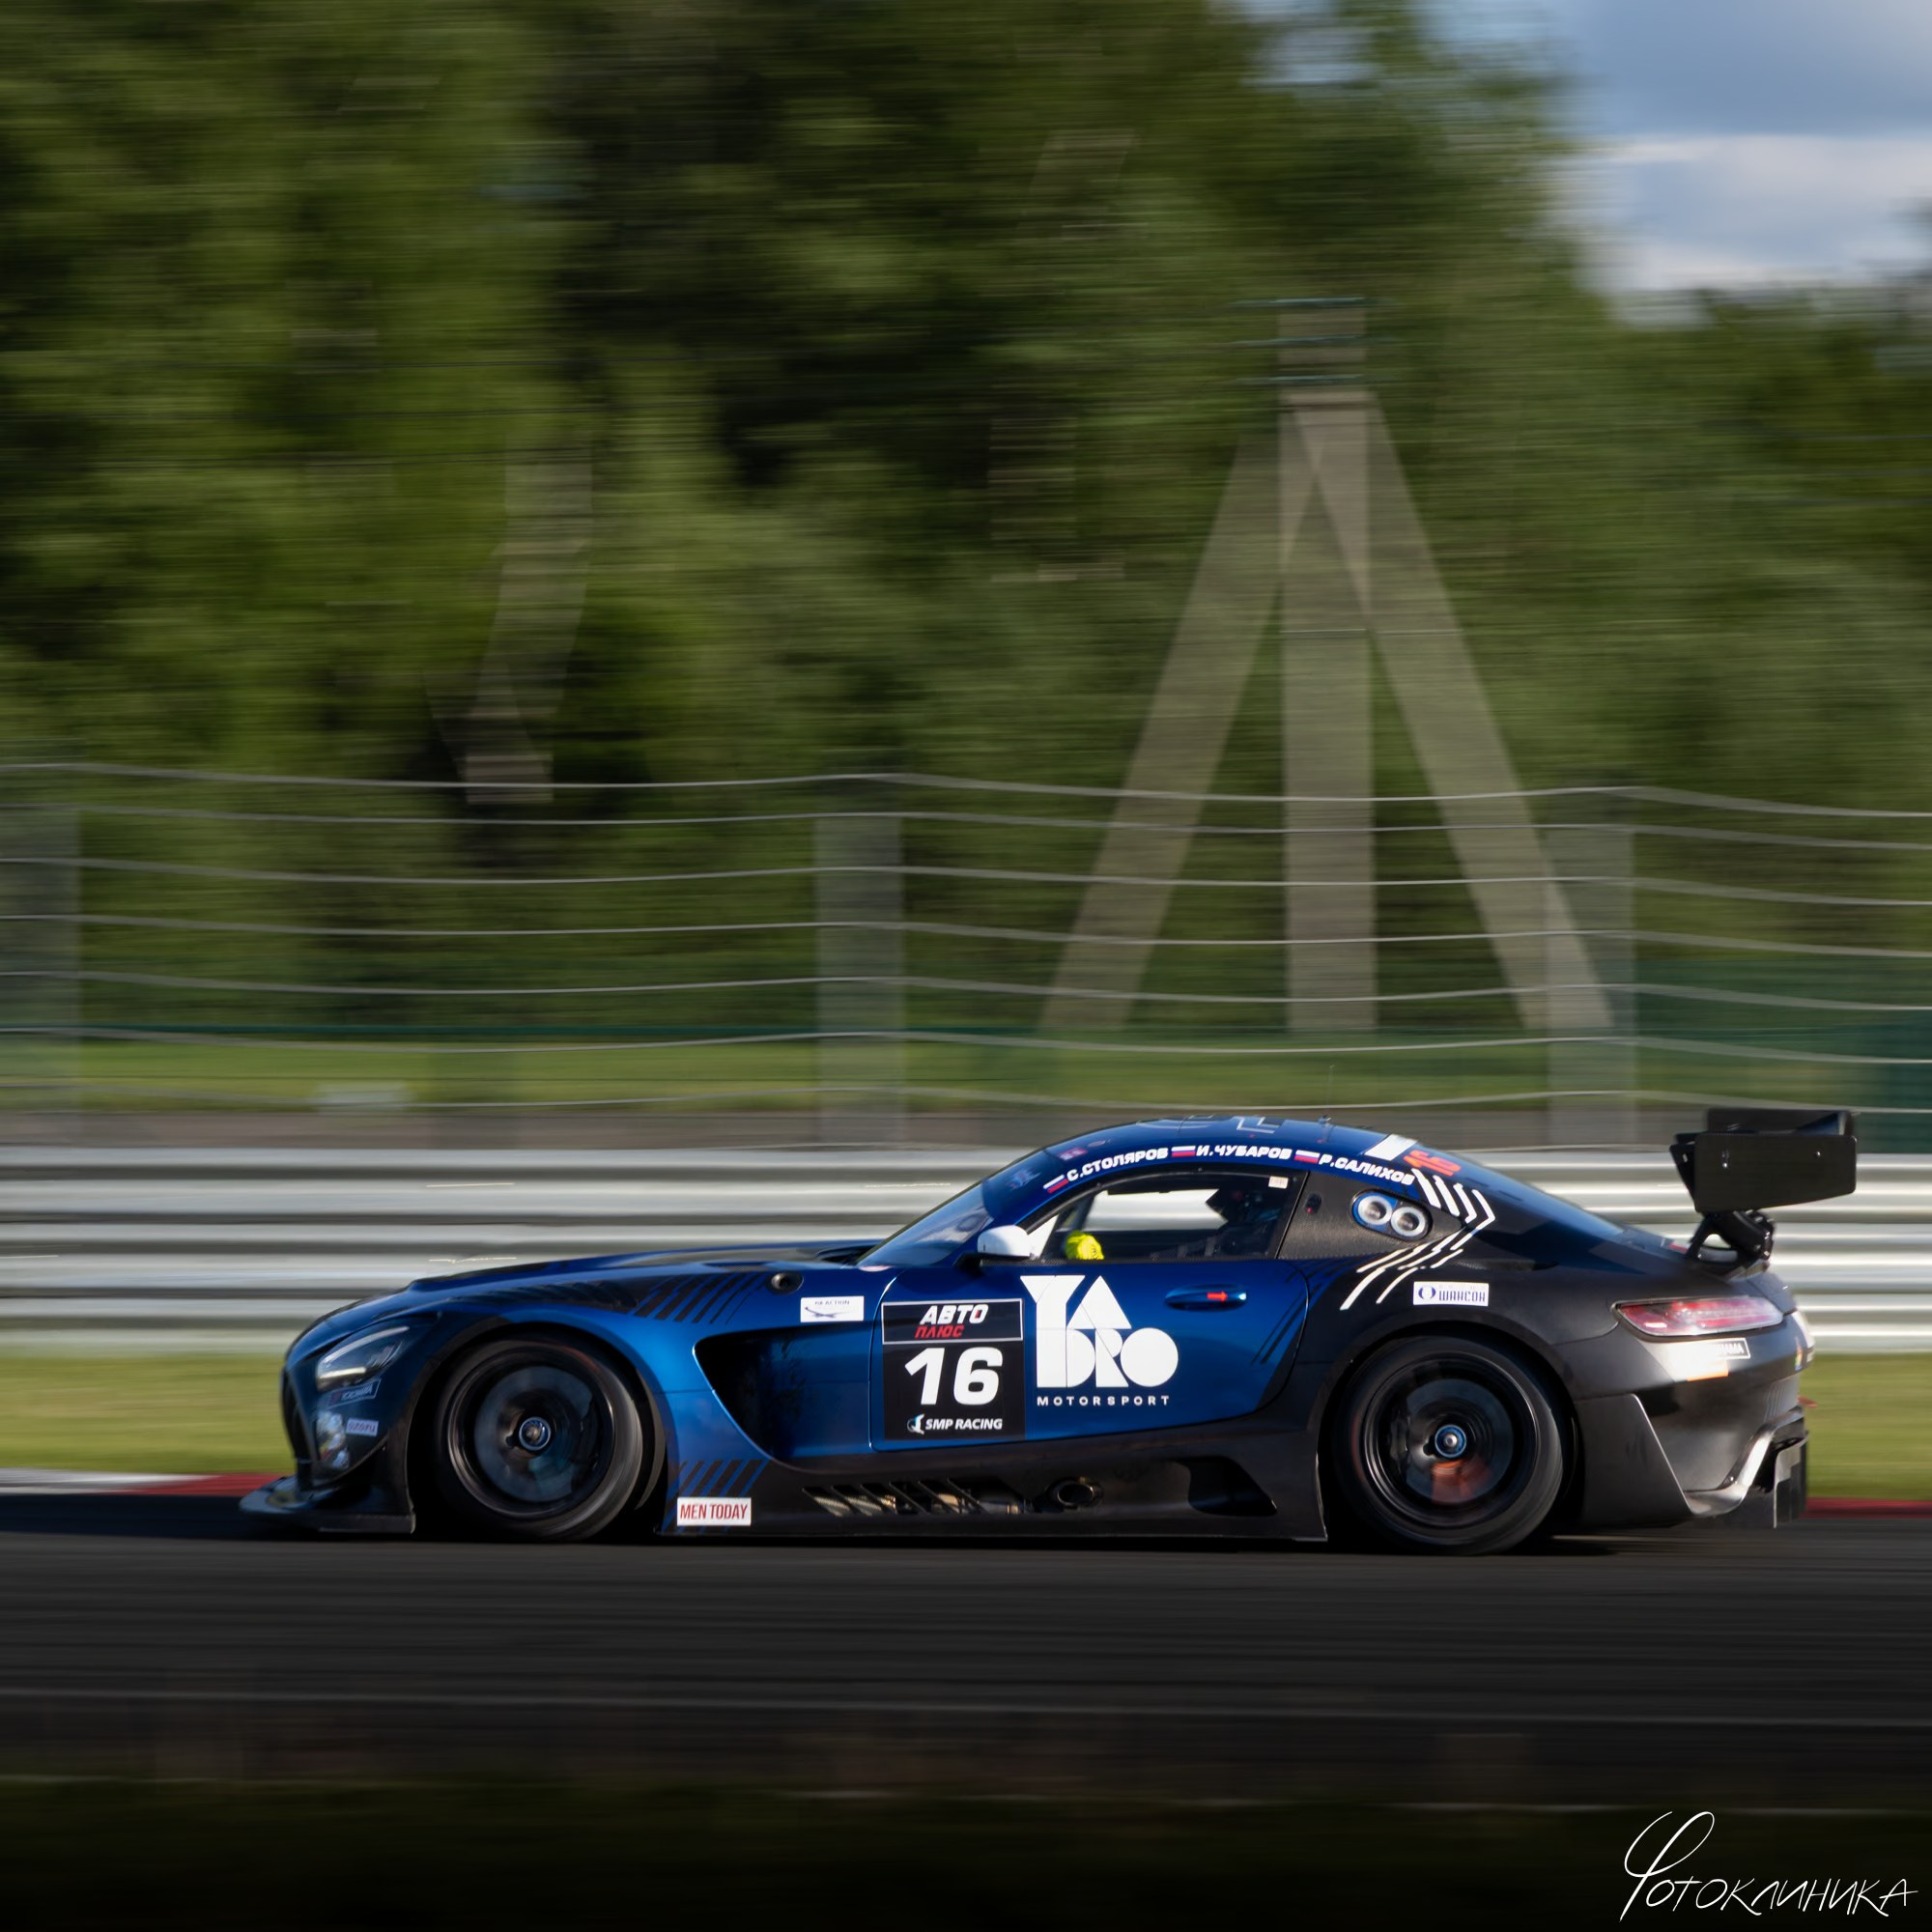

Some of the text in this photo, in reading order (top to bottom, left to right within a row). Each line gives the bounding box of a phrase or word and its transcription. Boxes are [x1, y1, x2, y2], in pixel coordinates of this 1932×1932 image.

[1066, 1145, 1416, 1186] С.СТОЛЯРОВ И.ЧУБАРОВ Р.САЛИХОВ
[1438, 1290, 1486, 1302] ШАНСОН
[920, 1304, 989, 1325] АВТО
[915, 1324, 965, 1339] ПЛЮС
[904, 1347, 1003, 1406] 16
[1037, 1395, 1170, 1406] MOTORSPORT
[924, 1418, 1003, 1430] SMP RACING
[679, 1503, 748, 1520] MEN TODAY
